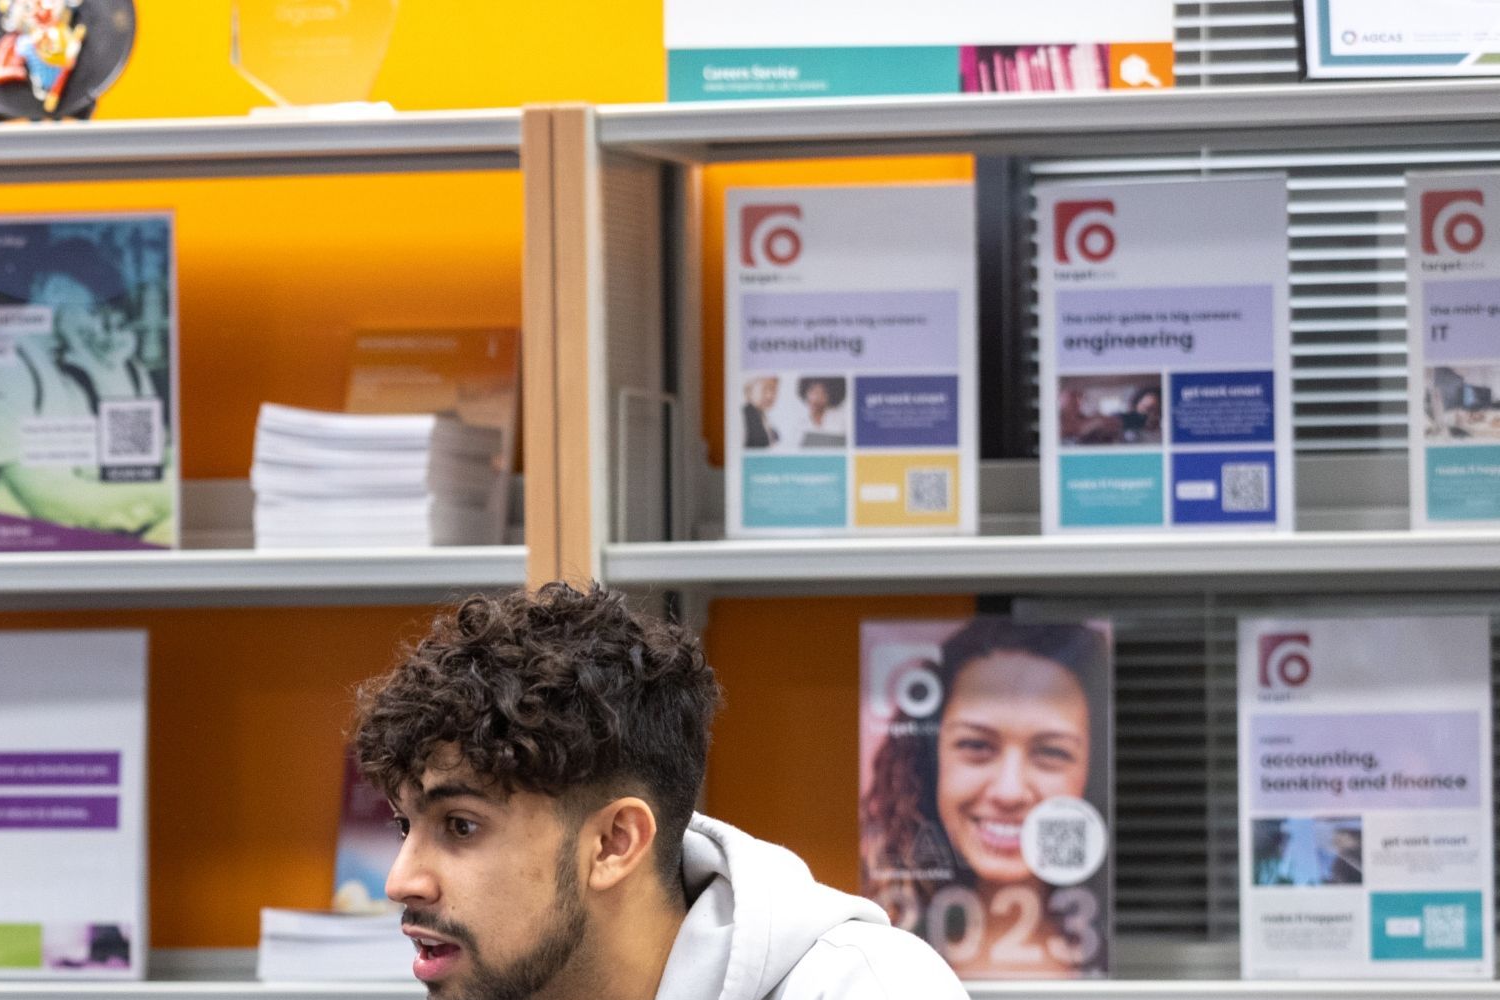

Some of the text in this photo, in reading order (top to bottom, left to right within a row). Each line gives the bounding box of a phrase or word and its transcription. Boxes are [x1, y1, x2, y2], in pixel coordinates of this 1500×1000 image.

[703, 63, 798, 81] Careers Service
[1063, 331, 1194, 354] engineering
[1431, 325, 1448, 342] IT
[748, 336, 864, 357] consulting
[1260, 751, 1379, 771] accounting,
[1260, 773, 1468, 794] banking and finance
